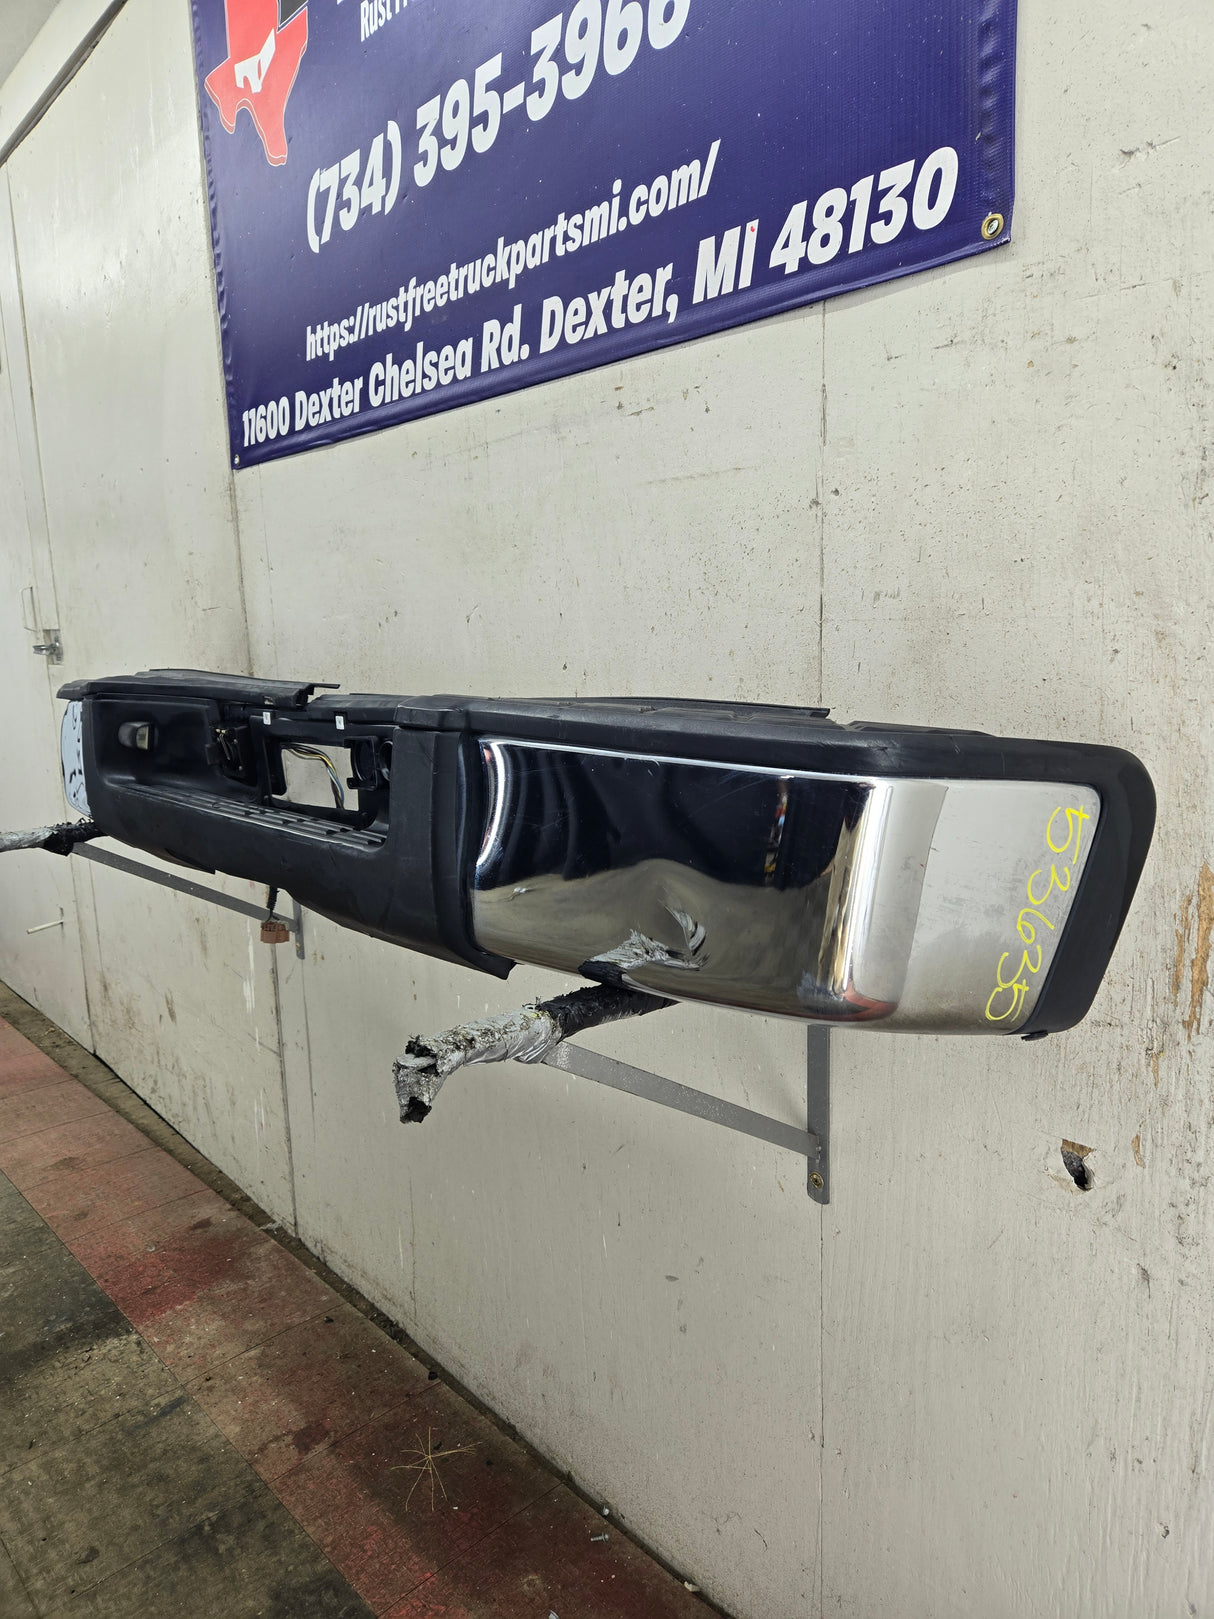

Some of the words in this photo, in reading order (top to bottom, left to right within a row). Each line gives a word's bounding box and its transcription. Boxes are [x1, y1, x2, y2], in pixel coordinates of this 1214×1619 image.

[242, 397, 290, 447] 11600
[294, 377, 364, 431] Dexter
[368, 337, 474, 407] Chelsea
[480, 304, 530, 373] Rd.
[539, 262, 679, 353] Dexter,
[692, 218, 759, 305] MI
[768, 146, 959, 275] 48130
[305, 138, 721, 361] https://rustfreetruckpartsmi.com/
[306, 120, 403, 254] (734)
[985, 805, 1090, 1022] 53635
